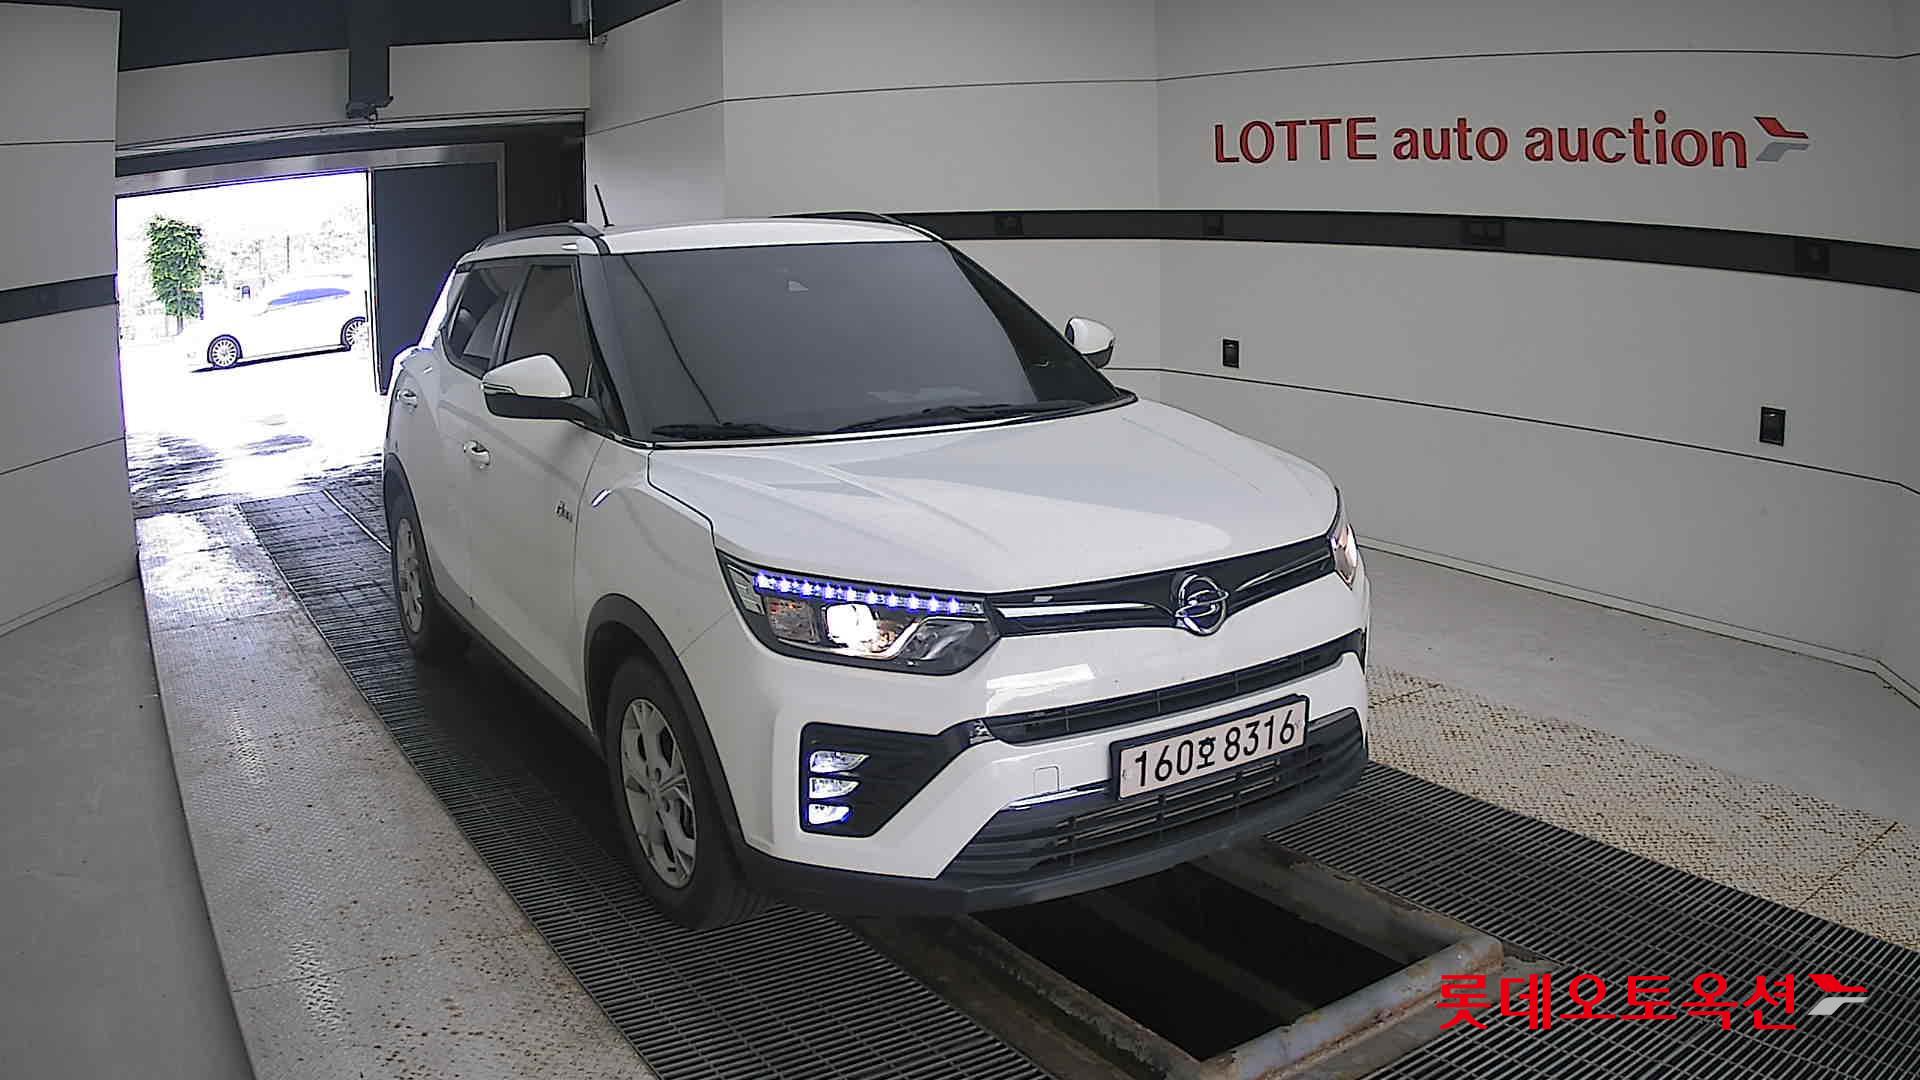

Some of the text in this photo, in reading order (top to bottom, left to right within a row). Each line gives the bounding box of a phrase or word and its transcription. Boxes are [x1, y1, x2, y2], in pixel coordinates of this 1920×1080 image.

[1214, 109, 1748, 168] LOTTE auto auction
